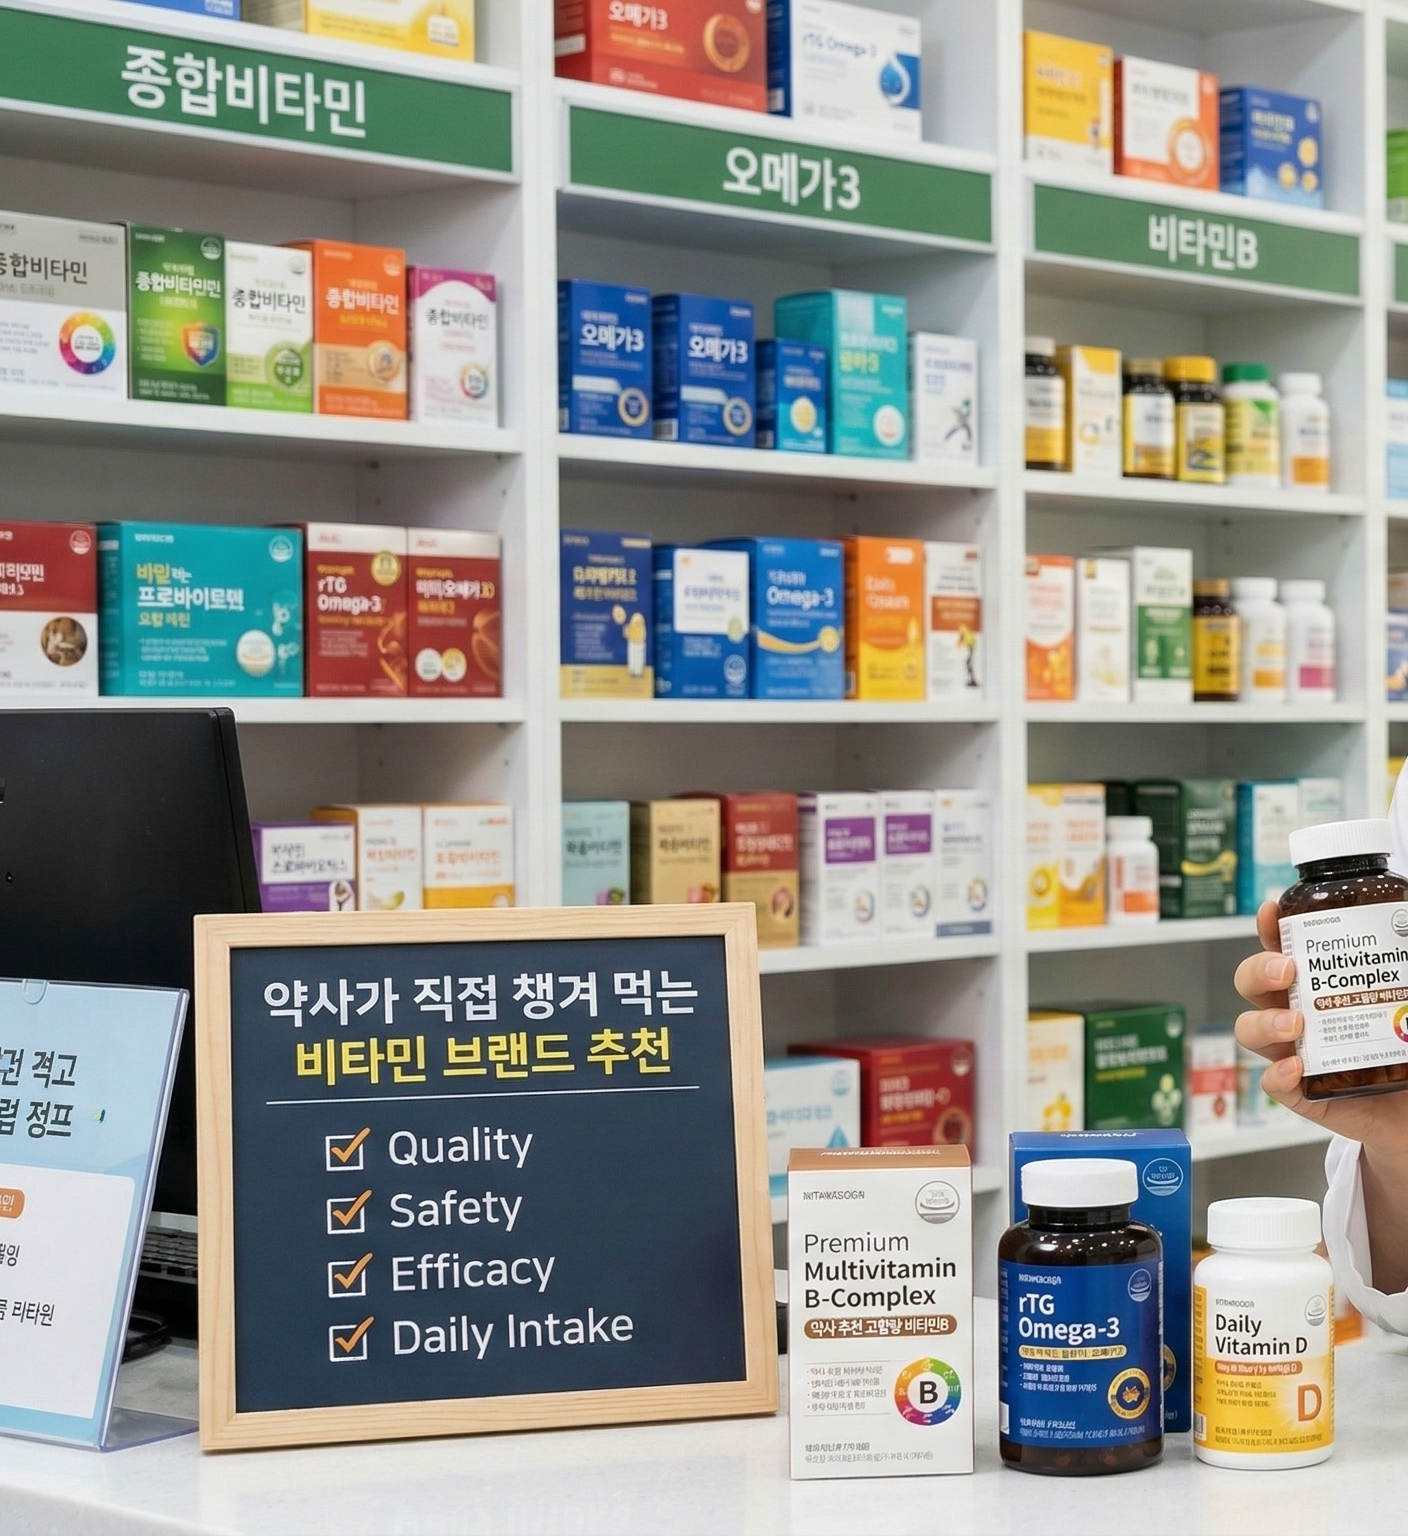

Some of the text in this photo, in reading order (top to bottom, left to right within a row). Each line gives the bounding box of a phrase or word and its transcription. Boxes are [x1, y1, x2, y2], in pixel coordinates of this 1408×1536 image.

[121, 45, 366, 138] 종합비타민
[722, 147, 860, 211] 오메가3
[1148, 214, 1258, 271] 비타민B
[579, 322, 645, 354] 오메가3
[766, 585, 834, 611] Omega-3
[1306, 934, 1377, 954] Premium
[1308, 947, 1408, 972] Multivitamin
[1311, 968, 1400, 991] B-Complex
[263, 970, 699, 1027] 약사가 직접 챙겨 먹는
[296, 1027, 671, 1086] 비타민 브랜드 추천
[26, 1101, 74, 1138] 정프
[388, 1127, 533, 1169] Quality
[390, 1190, 523, 1233] Safety
[805, 1232, 909, 1253] Premium
[391, 1253, 556, 1293] Efficacy
[805, 1257, 957, 1282] Multivitamin
[805, 1285, 936, 1311] B-Complex
[1019, 1293, 1055, 1316] rTG
[393, 1307, 634, 1360] Daily Intake
[1018, 1316, 1120, 1346] Omega-3
[1215, 1313, 1262, 1338] Daily
[1215, 1335, 1308, 1355] Vitamin D
[919, 1381, 939, 1404] B
[1297, 1383, 1323, 1422] D
